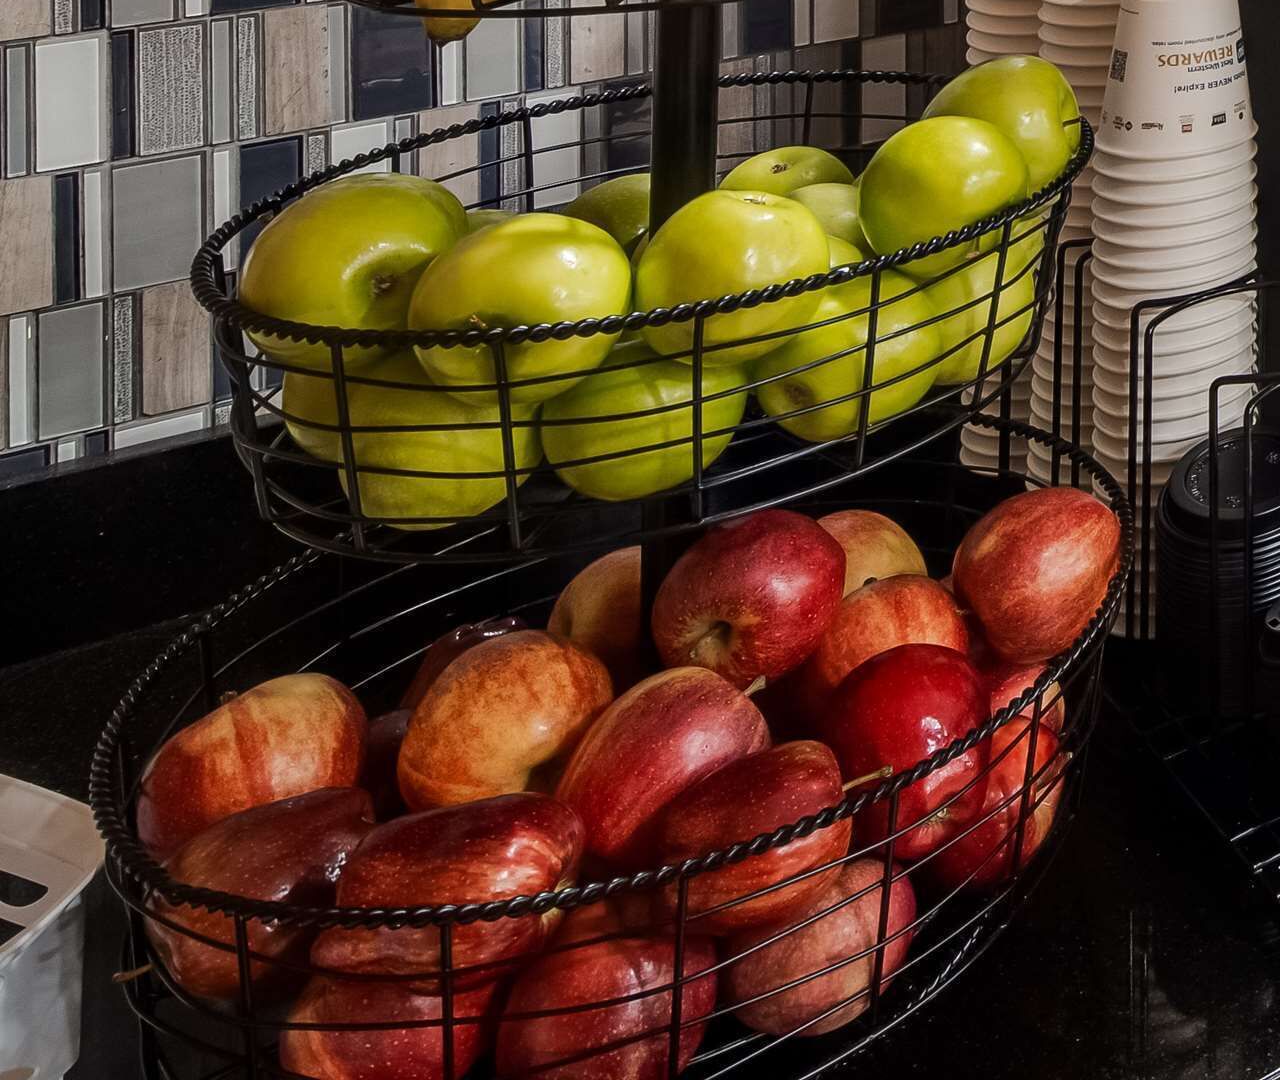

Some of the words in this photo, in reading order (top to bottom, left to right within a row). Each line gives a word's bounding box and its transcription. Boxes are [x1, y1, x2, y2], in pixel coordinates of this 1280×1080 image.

[1157, 44, 1233, 68] REWARDS
[1174, 83, 1205, 93] Expire!
[1208, 77, 1233, 88] NEVER
